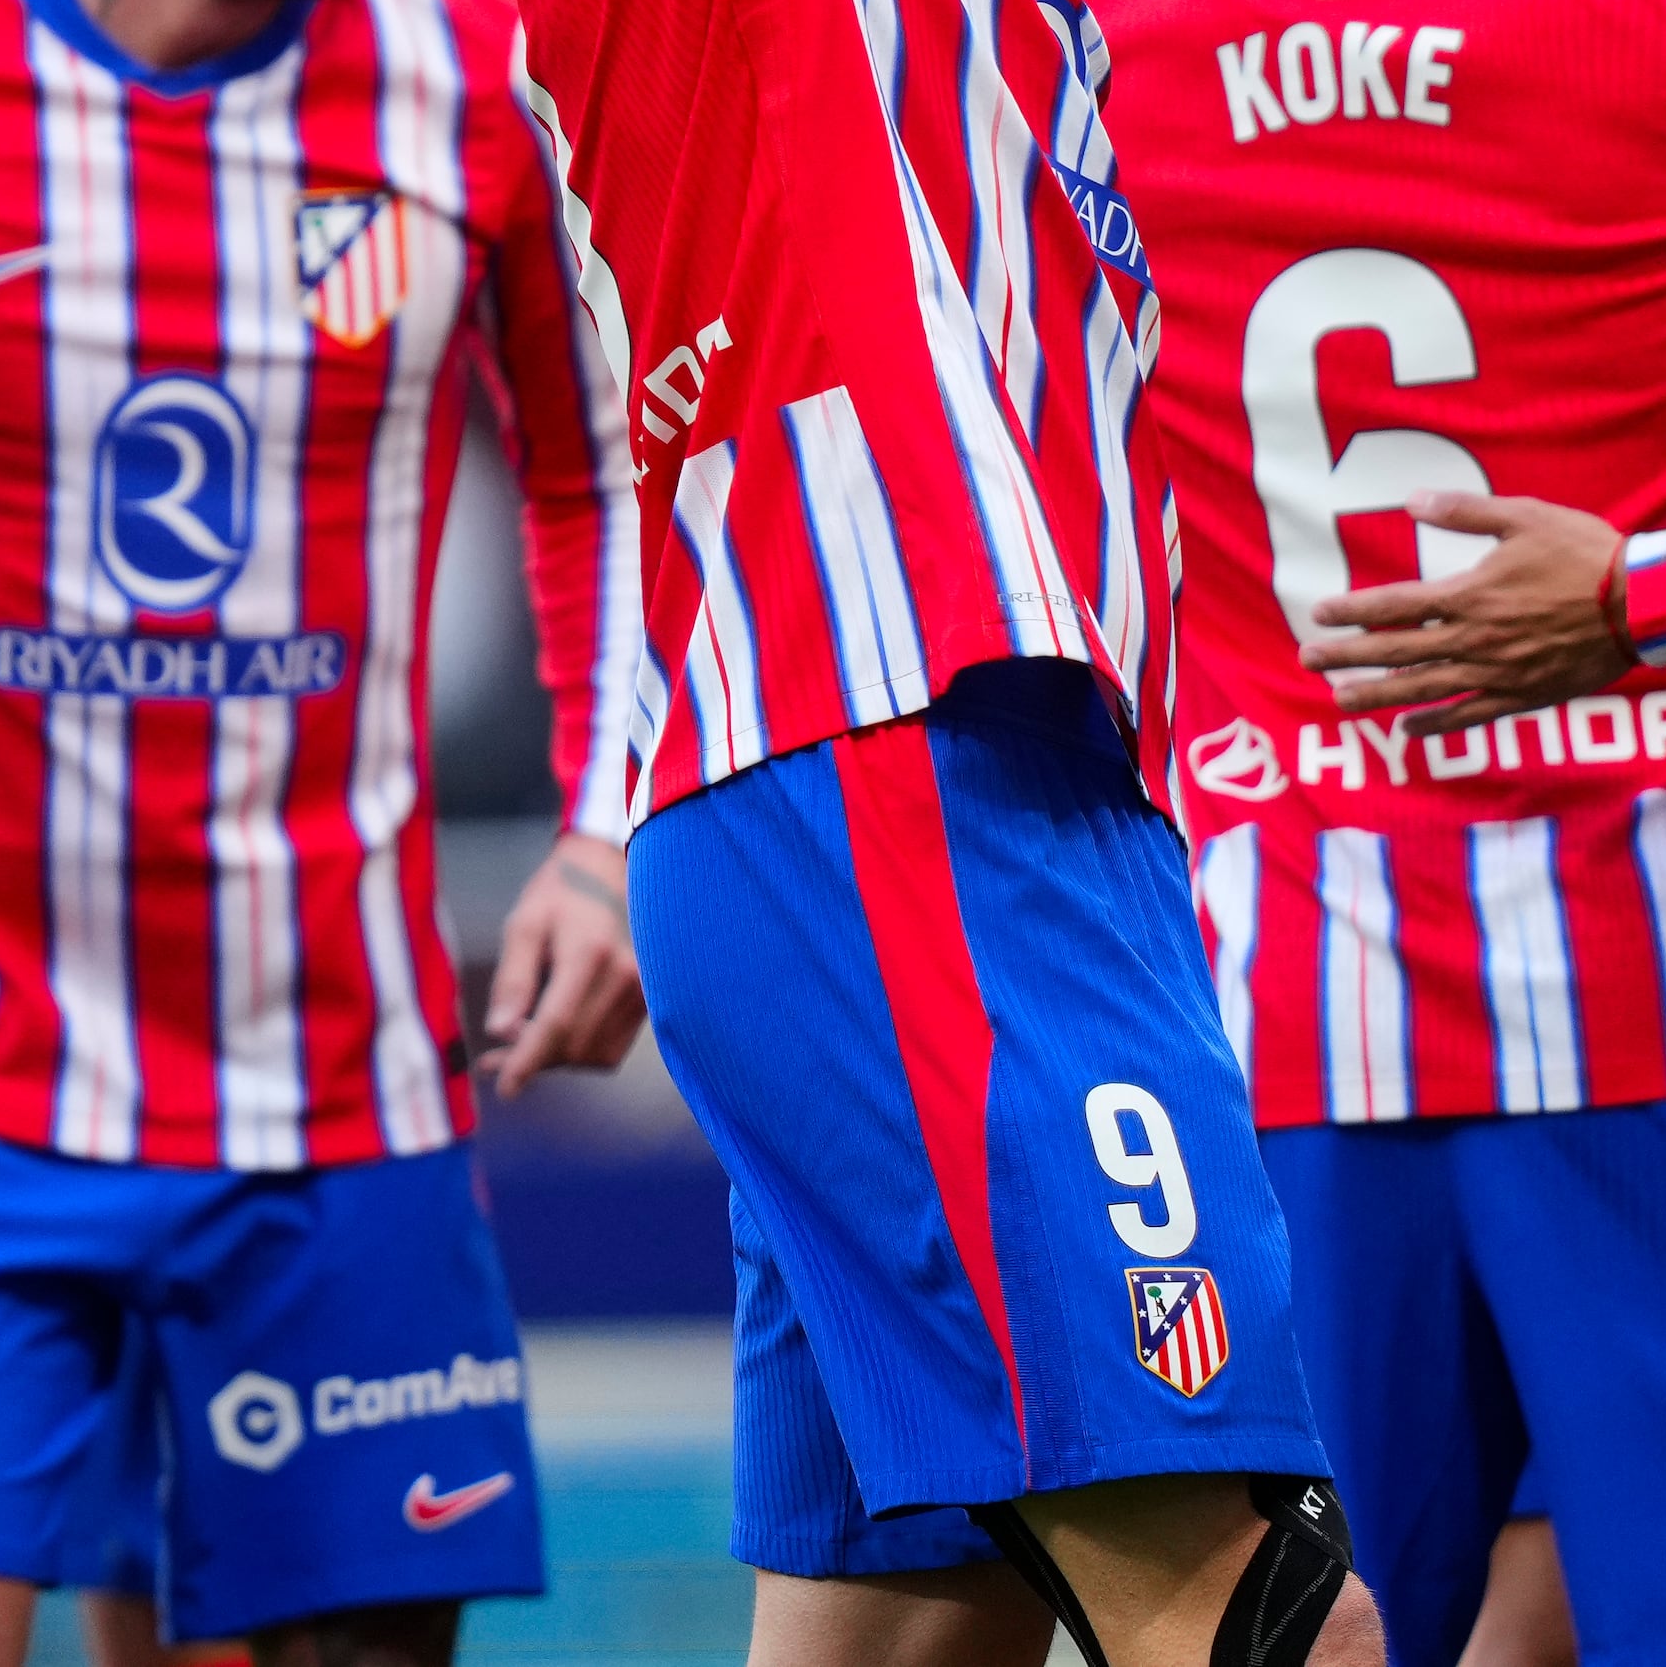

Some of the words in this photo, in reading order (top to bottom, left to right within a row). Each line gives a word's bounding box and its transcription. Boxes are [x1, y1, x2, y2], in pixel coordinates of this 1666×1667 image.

[1217, 20, 1465, 143] KOKE
[1241, 248, 1499, 682] 6
[234, 633, 341, 688] AIR
[1084, 1082, 1198, 1259] 9
[1299, 1484, 1326, 1520] KT
